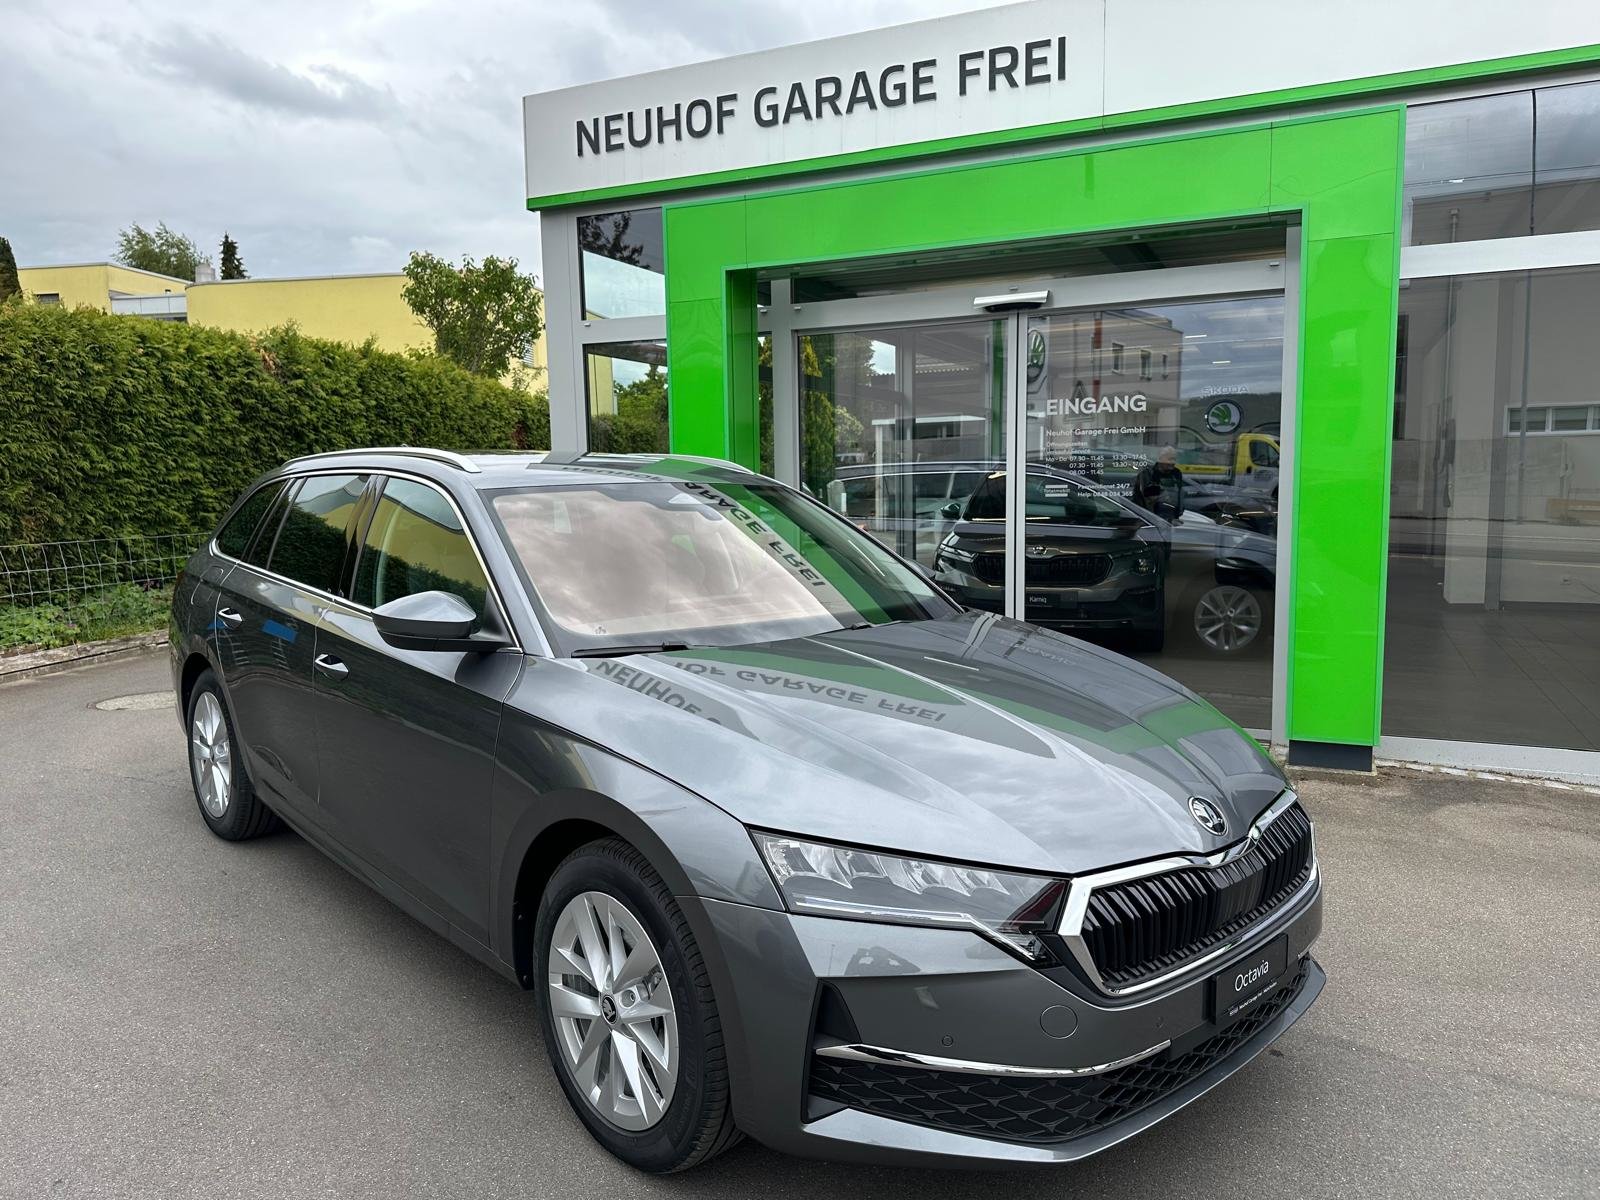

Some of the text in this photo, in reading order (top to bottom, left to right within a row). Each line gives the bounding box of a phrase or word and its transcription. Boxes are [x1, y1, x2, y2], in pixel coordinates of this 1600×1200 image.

[575, 36, 1066, 158] NEUHOF GARAGE FREI
[1046, 394, 1147, 416] EINGANG
[1046, 429, 1073, 437] Neuhof
[1074, 428, 1102, 437] Garage
[1120, 426, 1146, 434] GmbH
[1234, 959, 1269, 992] Octavia
